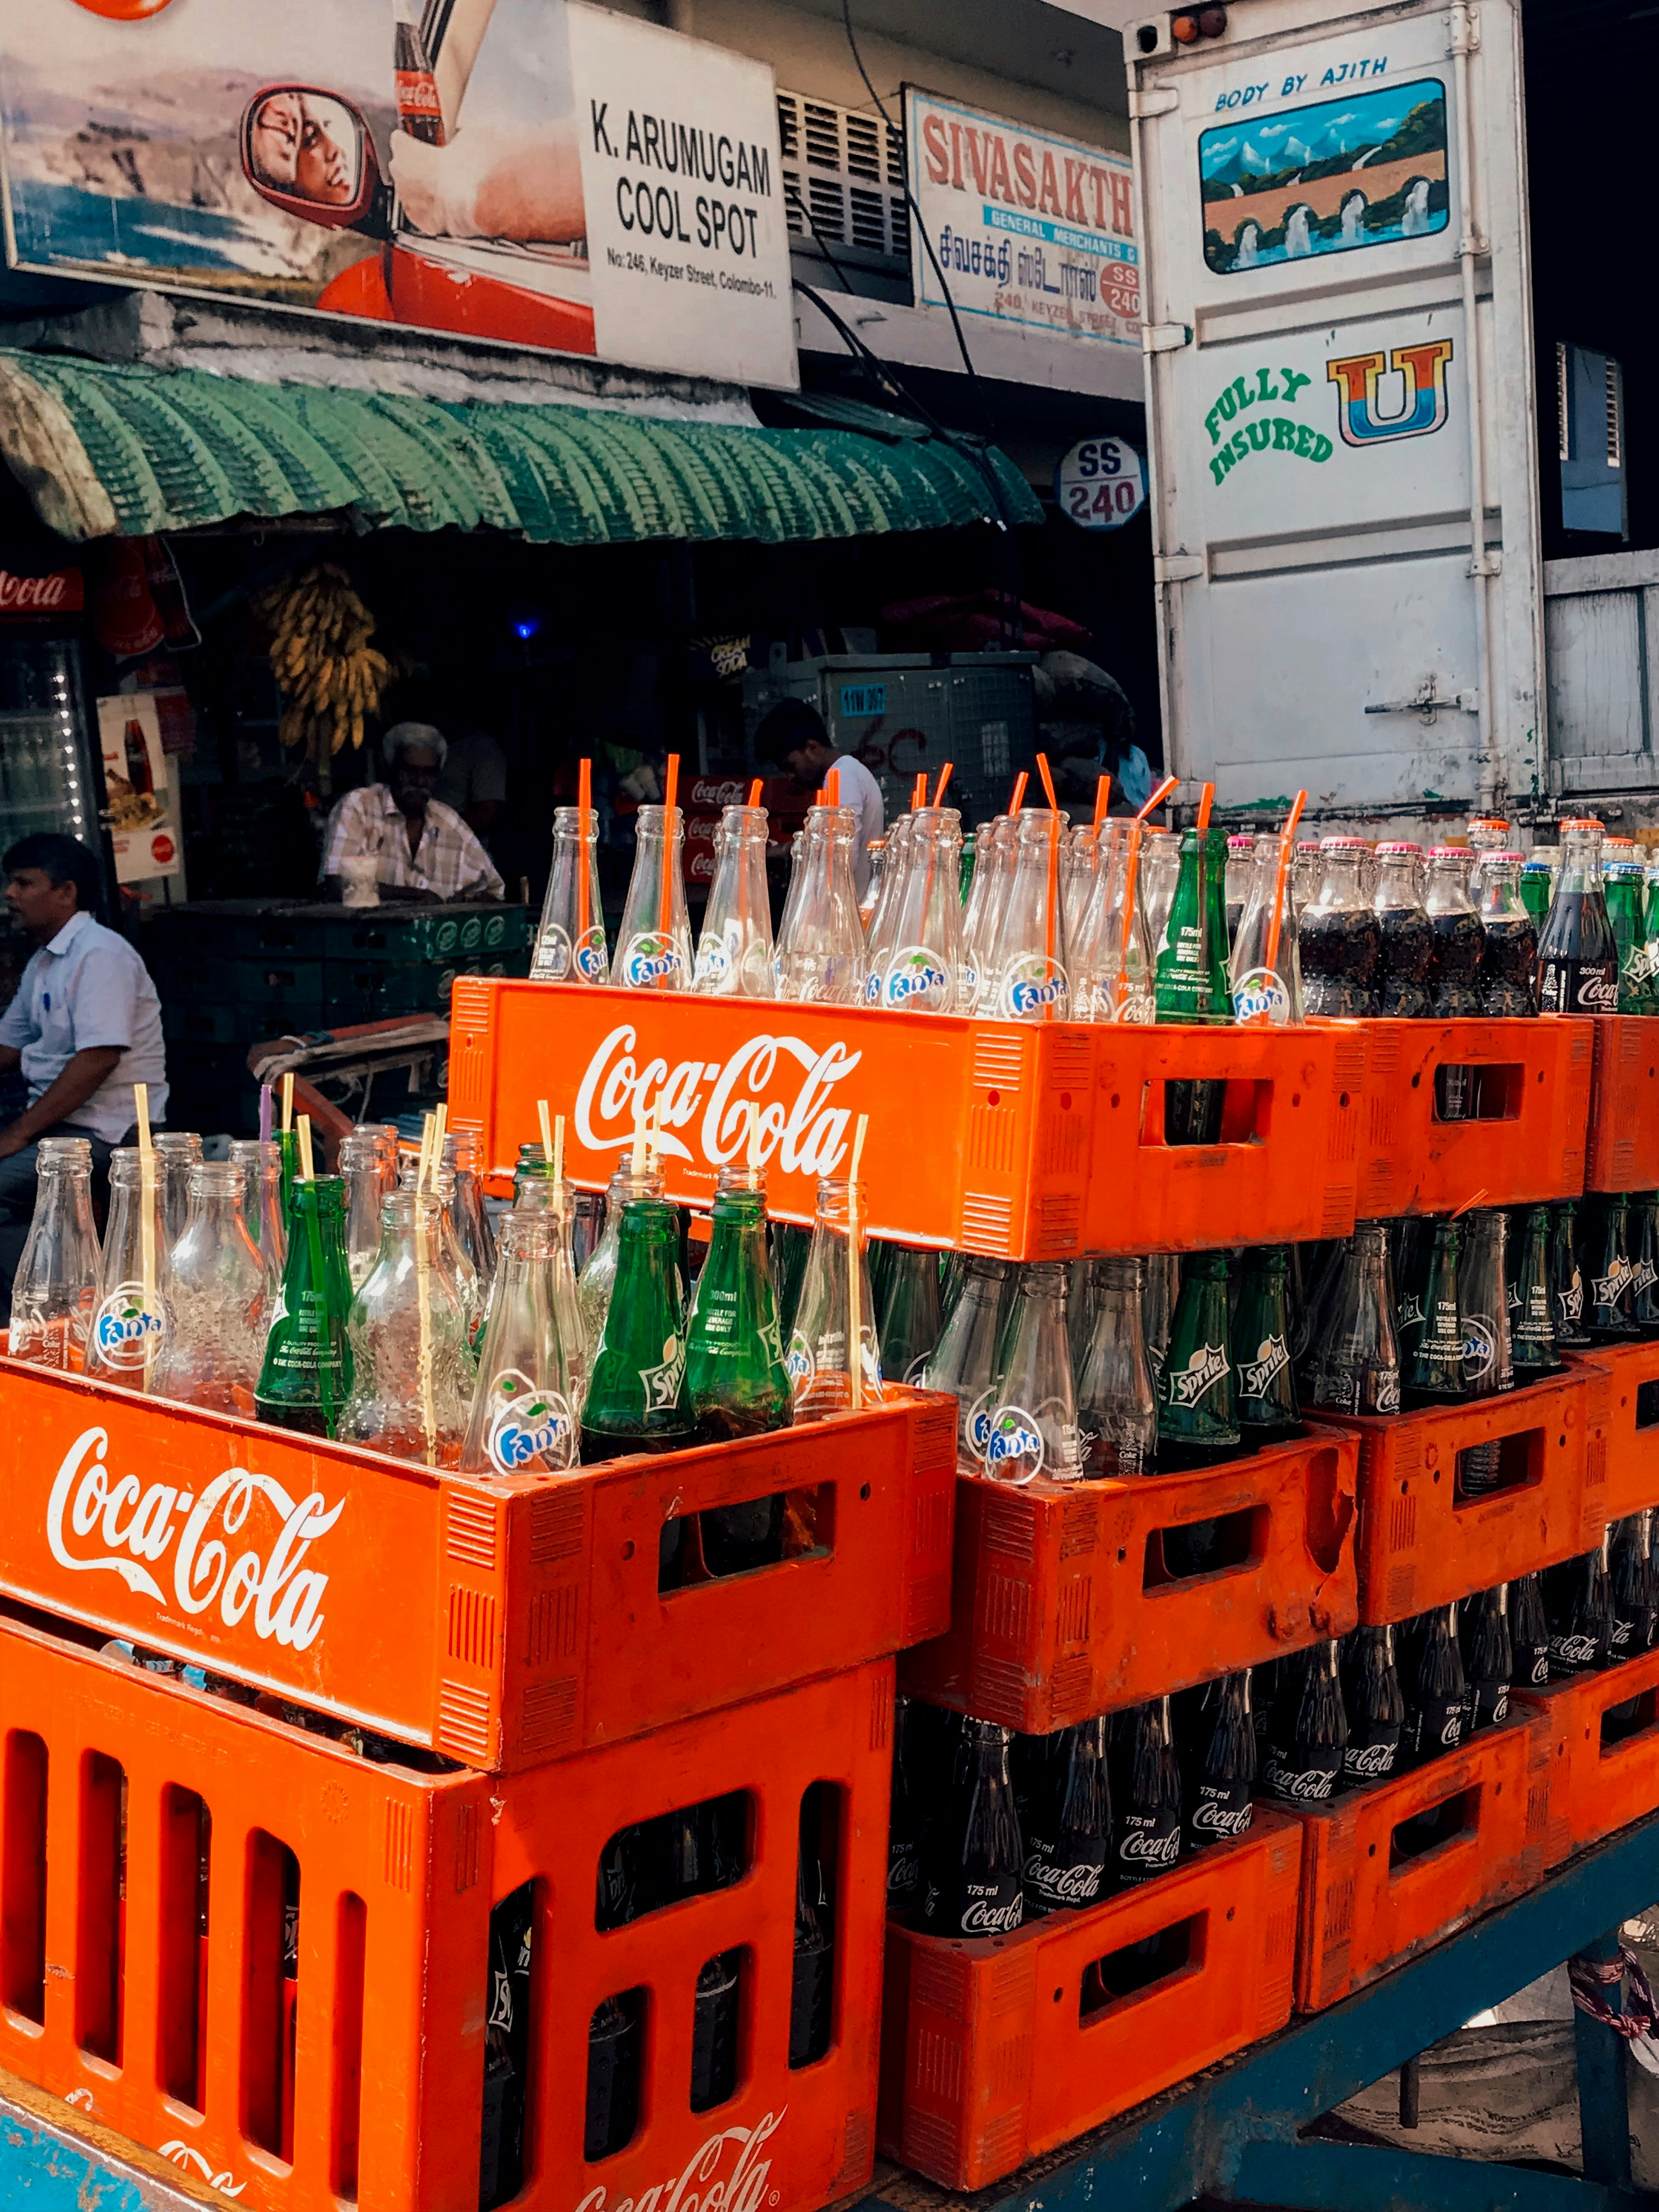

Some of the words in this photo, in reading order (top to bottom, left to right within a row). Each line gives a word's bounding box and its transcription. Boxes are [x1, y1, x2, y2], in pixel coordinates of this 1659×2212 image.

[1214, 82, 1269, 112] BODY
[1280, 74, 1308, 97] BY
[1320, 57, 1388, 86] AJITH
[591, 99, 619, 158] K.
[626, 110, 771, 198] ARUMUGAM
[616, 177, 691, 243] COOL
[696, 195, 758, 258] SPOT
[991, 210, 1046, 239] GENERAL
[1053, 227, 1121, 258] MERCHANTS
[650, 255, 684, 282] Keyzer
[1113, 266, 1136, 285] SS
[1110, 288, 1141, 313] 240
[1204, 368, 1312, 445] FULLY
[1078, 442, 1121, 476] SS
[1209, 417, 1334, 487] INSURED
[1069, 481, 1135, 523] 240
[1181, 927, 1203, 938] 175ml
[629, 949, 684, 985] Fanta
[888, 966, 945, 1005] Fanta
[1579, 967, 1595, 975] 300
[1009, 978, 1069, 1015] Fanta
[1233, 987, 1284, 1023] Fanta
[574, 1024, 862, 1177] Coca-Cola
[710, 1289, 737, 1302] 300ml
[1599, 1265, 1629, 1302] Sprite
[99, 1311, 162, 1352] Fanta
[1177, 1353, 1222, 1401] Sprite
[1245, 1343, 1284, 1393] Sprite
[496, 1413, 571, 1468] Fanta
[989, 1427, 1041, 1464] Fanta
[47, 1426, 346, 1651] Coca-Cola
[156, 1611, 186, 1630] Trademark
[1200, 1786, 1217, 1798] 175
[1217, 1790, 1231, 1800] ml
[1263, 1759, 1338, 1799] Coca-Cola
[1125, 1815, 1142, 1827] 175
[1143, 1817, 1156, 1827] ml
[1030, 1837, 1042, 1849] 175
[1041, 1843, 1054, 1854] ml
[967, 1885, 984, 1896] 175
[985, 1885, 999, 1895] ml
[1023, 1854, 1105, 1897] Coca-Cola
